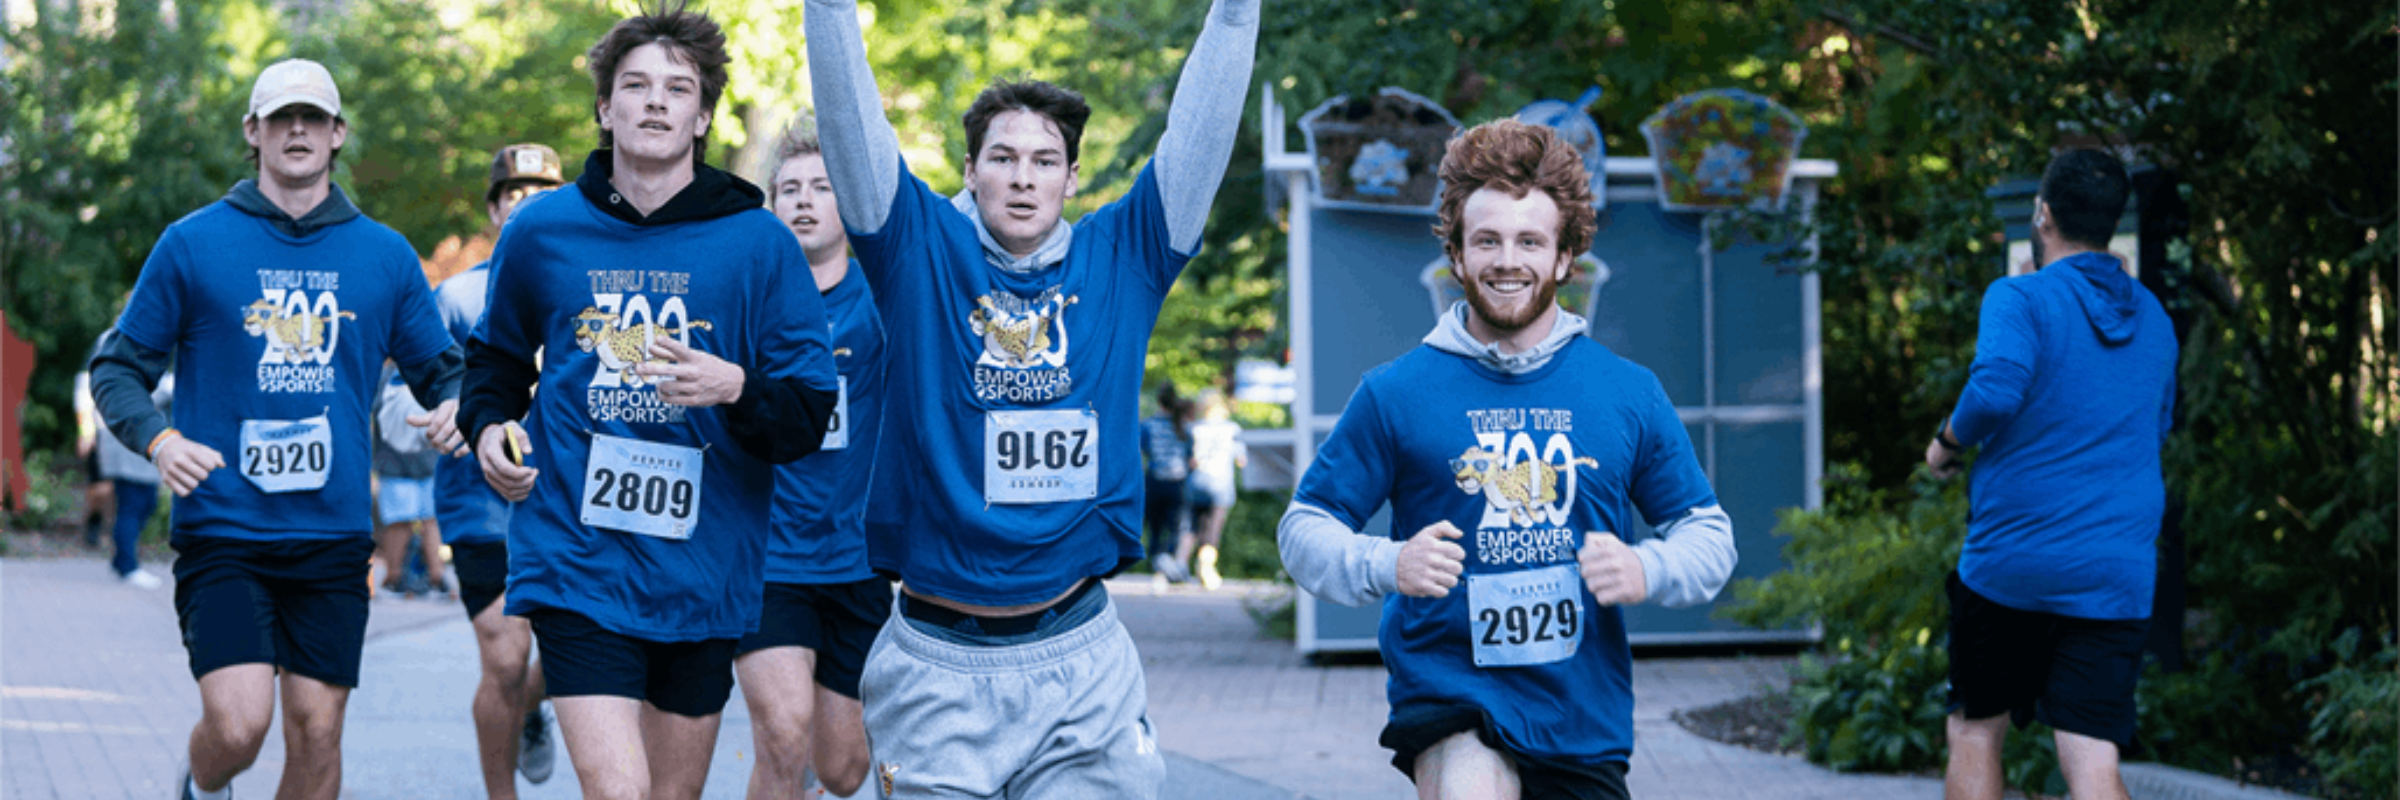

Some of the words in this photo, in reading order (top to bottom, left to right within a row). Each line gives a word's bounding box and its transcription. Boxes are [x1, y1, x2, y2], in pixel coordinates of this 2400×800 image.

[257, 269, 304, 290] THRU
[305, 270, 339, 290] THE
[587, 270, 645, 293] THRU
[648, 271, 690, 294] THE
[258, 288, 339, 365] ZOO
[257, 365, 335, 381] EMPOWER
[974, 366, 1072, 387] EMPOWER
[268, 379, 324, 393] SPORTS
[984, 383, 1054, 402] SPORTS
[587, 389, 685, 407] EMPOW
[600, 405, 668, 424] SPORTS
[1466, 408, 1527, 433] THRU
[1530, 408, 1573, 432] THE
[246, 440, 325, 476] 2920
[997, 428, 1090, 471] 2916
[1476, 431, 1577, 530] ZOO
[590, 467, 694, 520] 2809
[1476, 528, 1575, 550] EMPOWER
[1490, 546, 1557, 566] SPORTS
[1479, 598, 1578, 645] 2929
